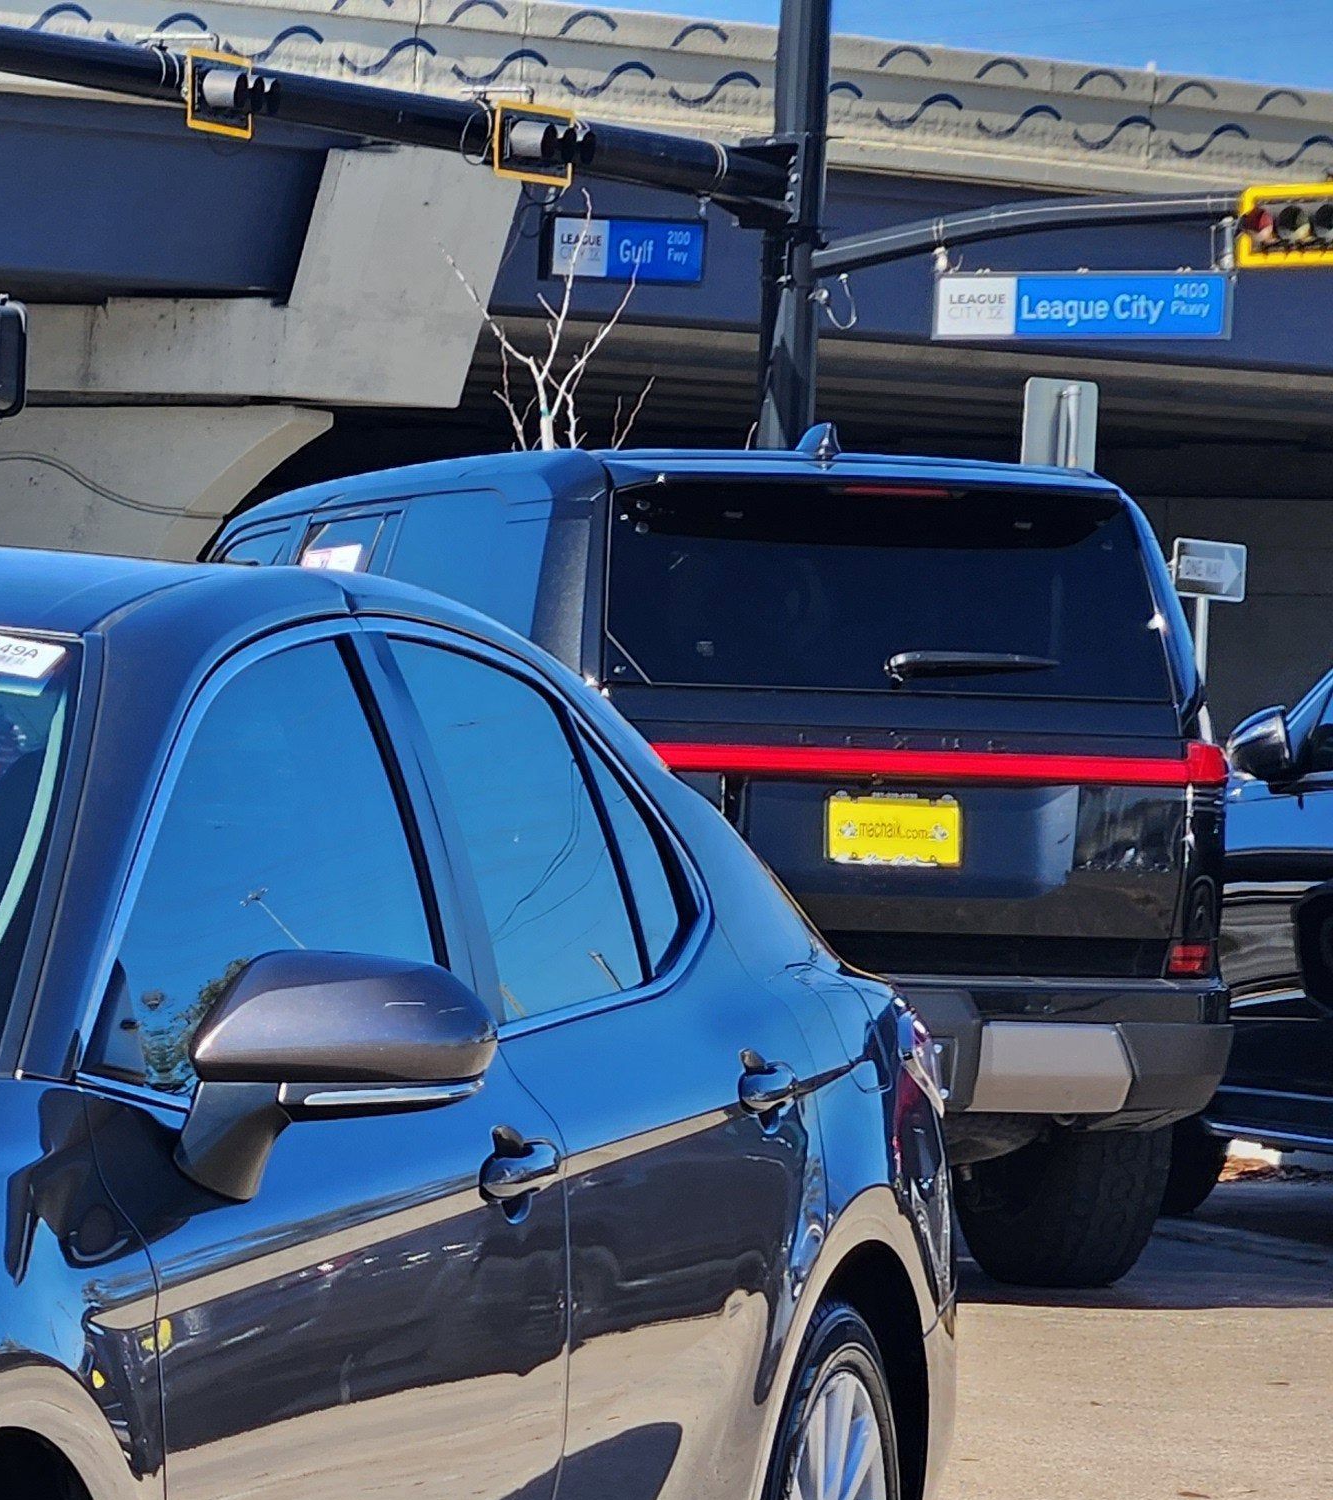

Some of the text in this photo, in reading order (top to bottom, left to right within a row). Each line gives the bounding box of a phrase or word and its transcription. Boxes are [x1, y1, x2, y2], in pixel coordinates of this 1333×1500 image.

[667, 230, 691, 245] 2100
[619, 239, 654, 265] Gulf
[667, 248, 689, 265] Fwy
[949, 293, 1006, 305] LEAGUE
[1173, 282, 1209, 299] 1400
[948, 306, 982, 321] CITY
[1020, 293, 1165, 327] League City
[1170, 300, 1210, 318] Pkwy
